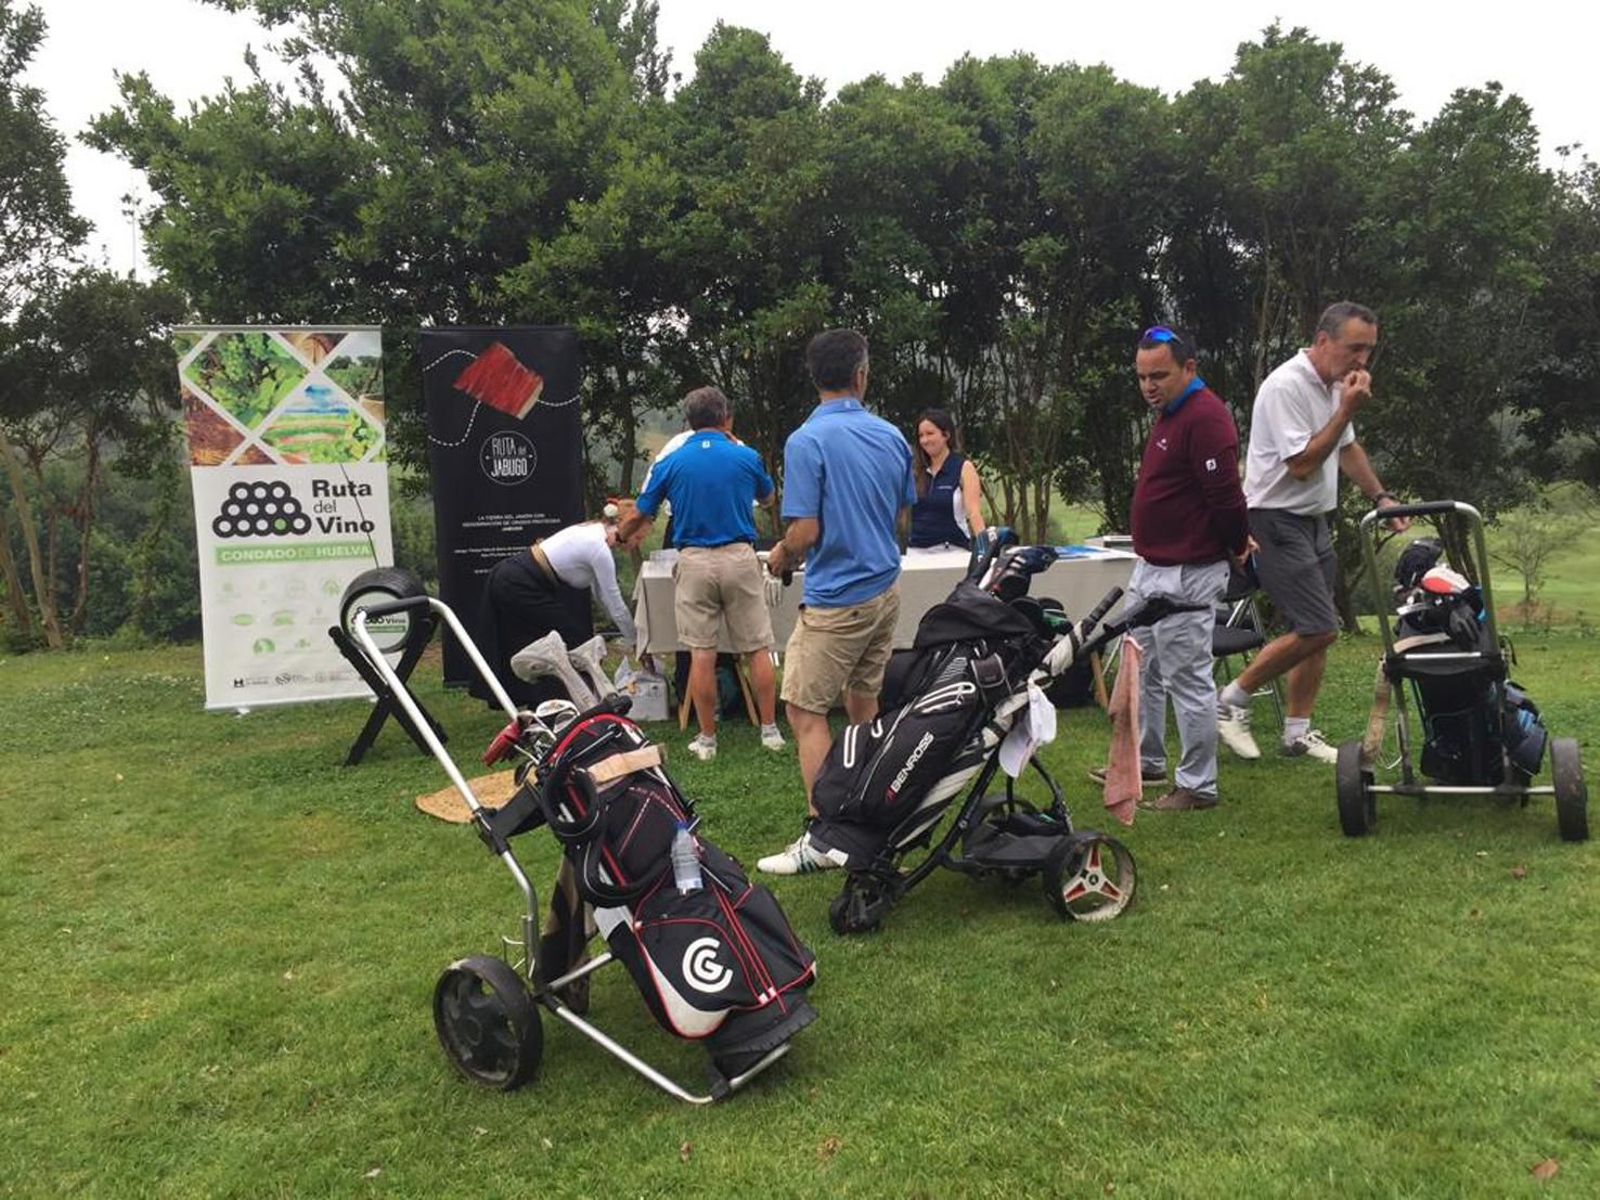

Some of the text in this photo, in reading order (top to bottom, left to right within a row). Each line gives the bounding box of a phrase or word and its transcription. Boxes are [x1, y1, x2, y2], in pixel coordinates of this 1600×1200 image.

[492, 437, 516, 456] RUTA
[491, 458, 528, 477] JABUGO
[312, 479, 372, 498] Ruta
[313, 500, 337, 514] del
[316, 516, 375, 534] Vino
[221, 548, 296, 562] CONDADO
[316, 544, 370, 557] HUELVA
[890, 731, 934, 793] BENROSS
